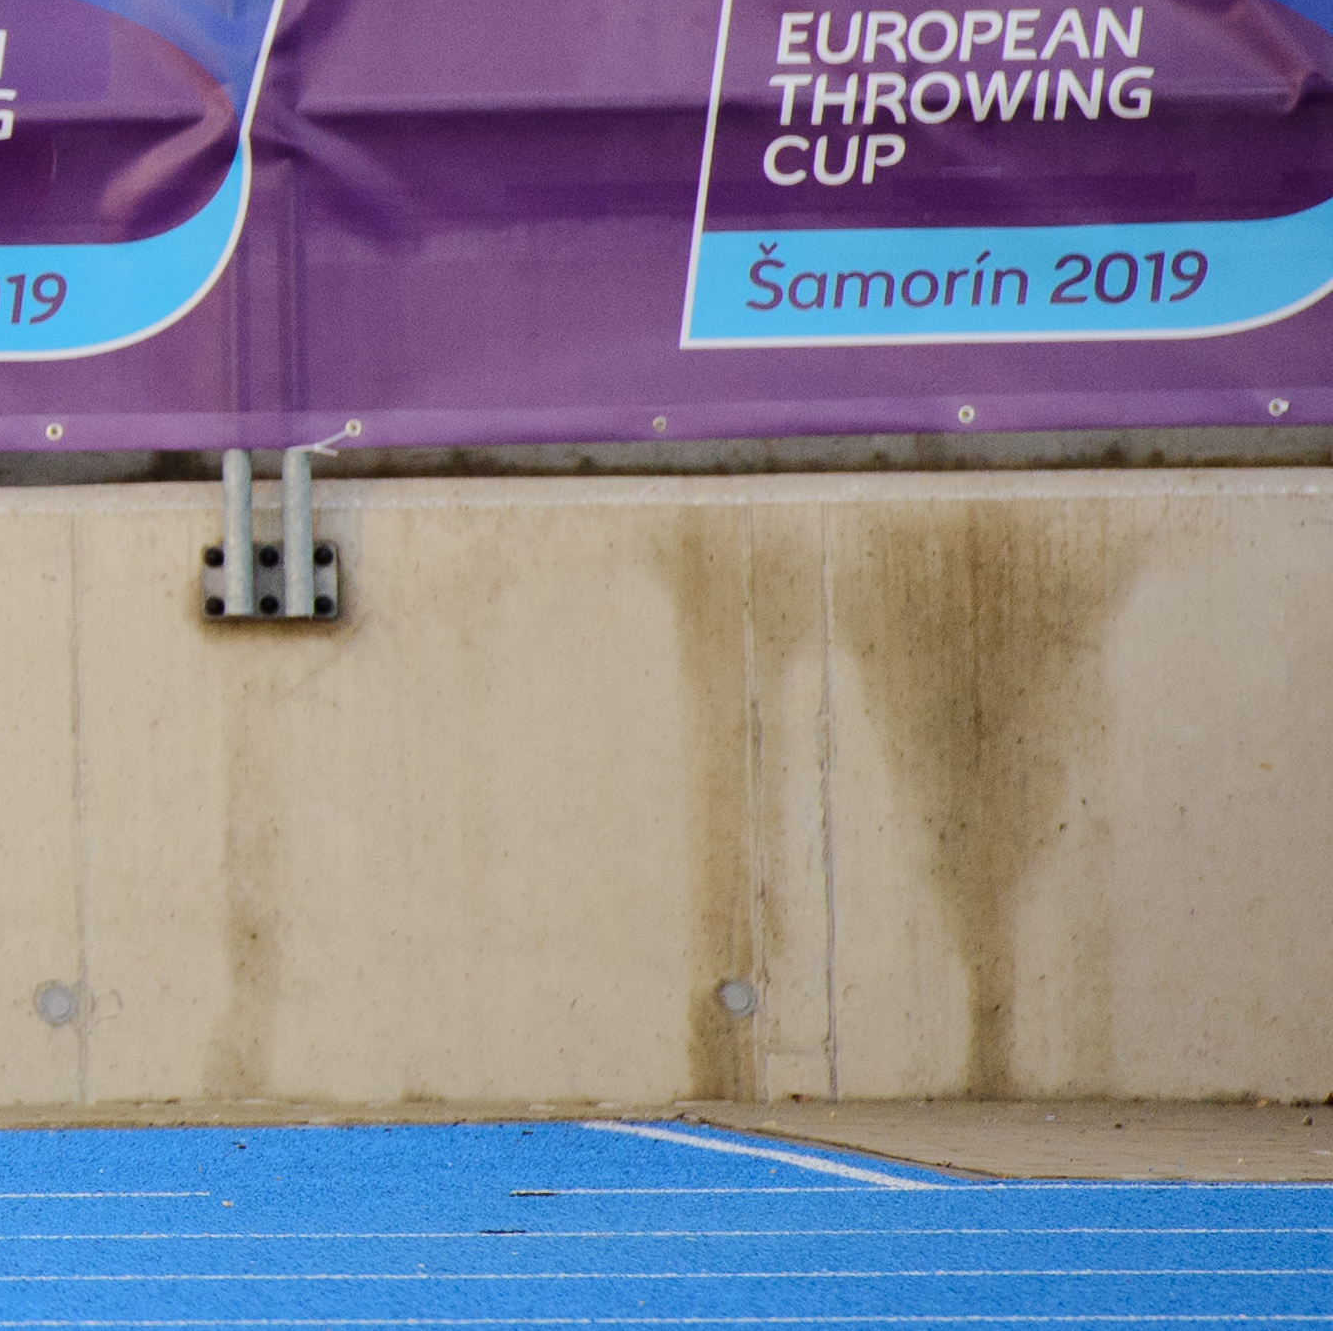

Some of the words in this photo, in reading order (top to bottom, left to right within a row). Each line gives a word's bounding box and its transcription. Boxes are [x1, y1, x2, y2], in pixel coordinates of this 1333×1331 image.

[775, 6, 1144, 65] EUROPEAN
[768, 66, 1155, 126] THROWING
[762, 134, 906, 186] CUP
[745, 242, 1030, 312] Šamorín
[1049, 248, 1209, 306] 2019
